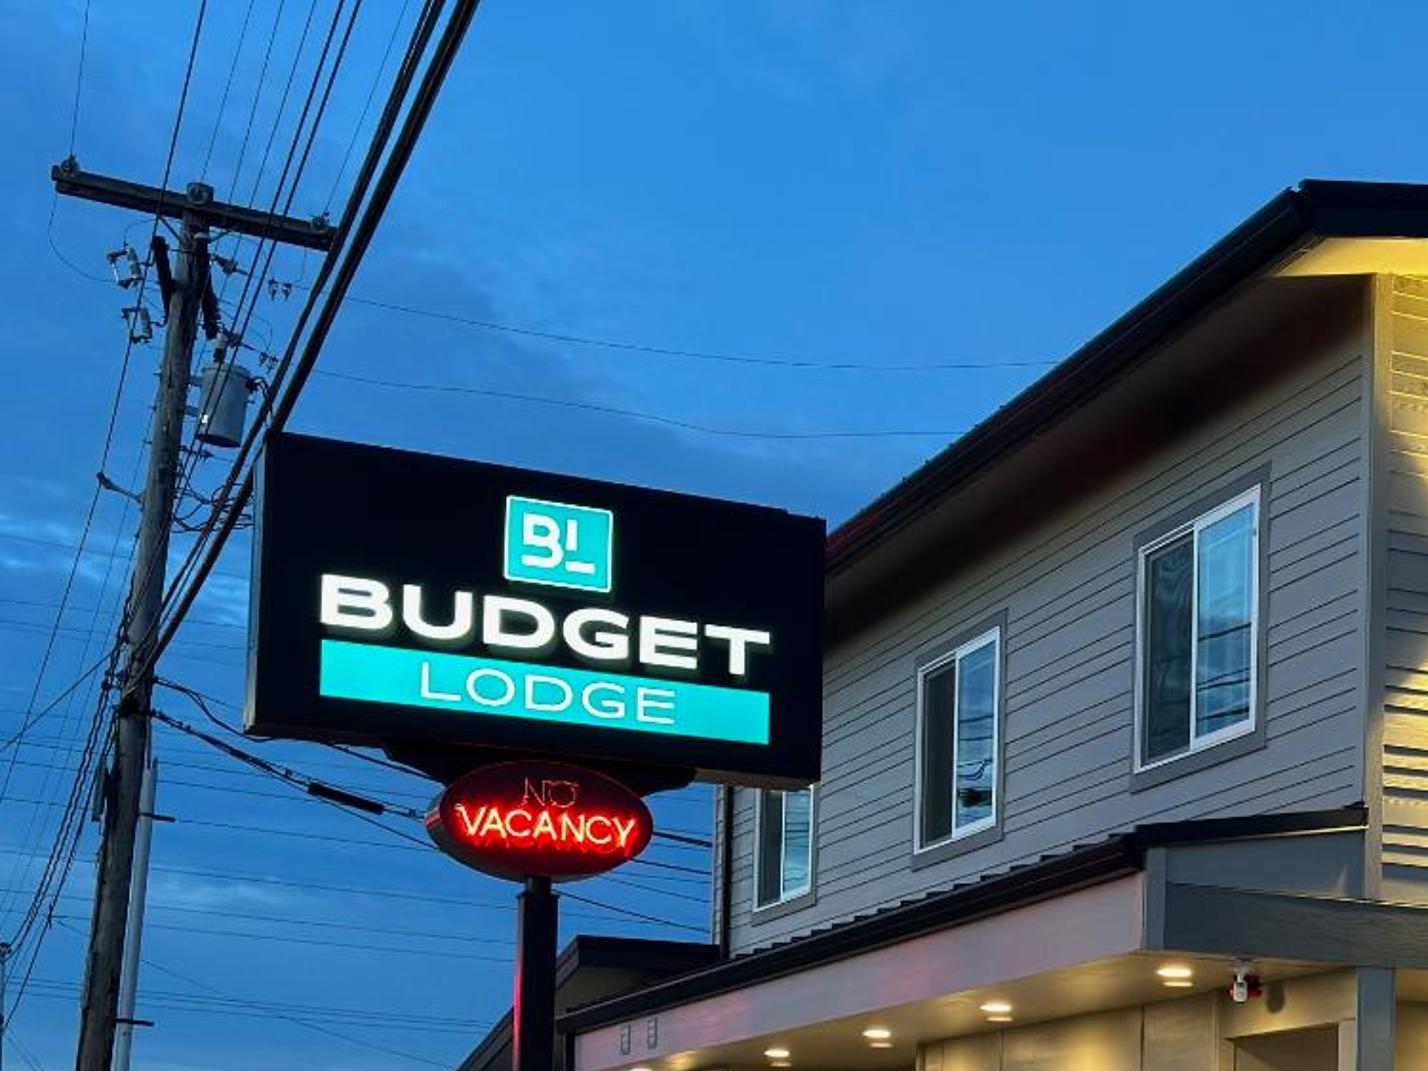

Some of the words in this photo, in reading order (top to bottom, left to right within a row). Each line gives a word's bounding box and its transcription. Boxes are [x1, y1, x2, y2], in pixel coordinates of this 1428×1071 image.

[521, 512, 597, 574] BL
[320, 573, 771, 676] BUDGET
[419, 661, 677, 726] LODGE
[520, 776, 580, 808] NO
[455, 802, 636, 848] VACANCY
